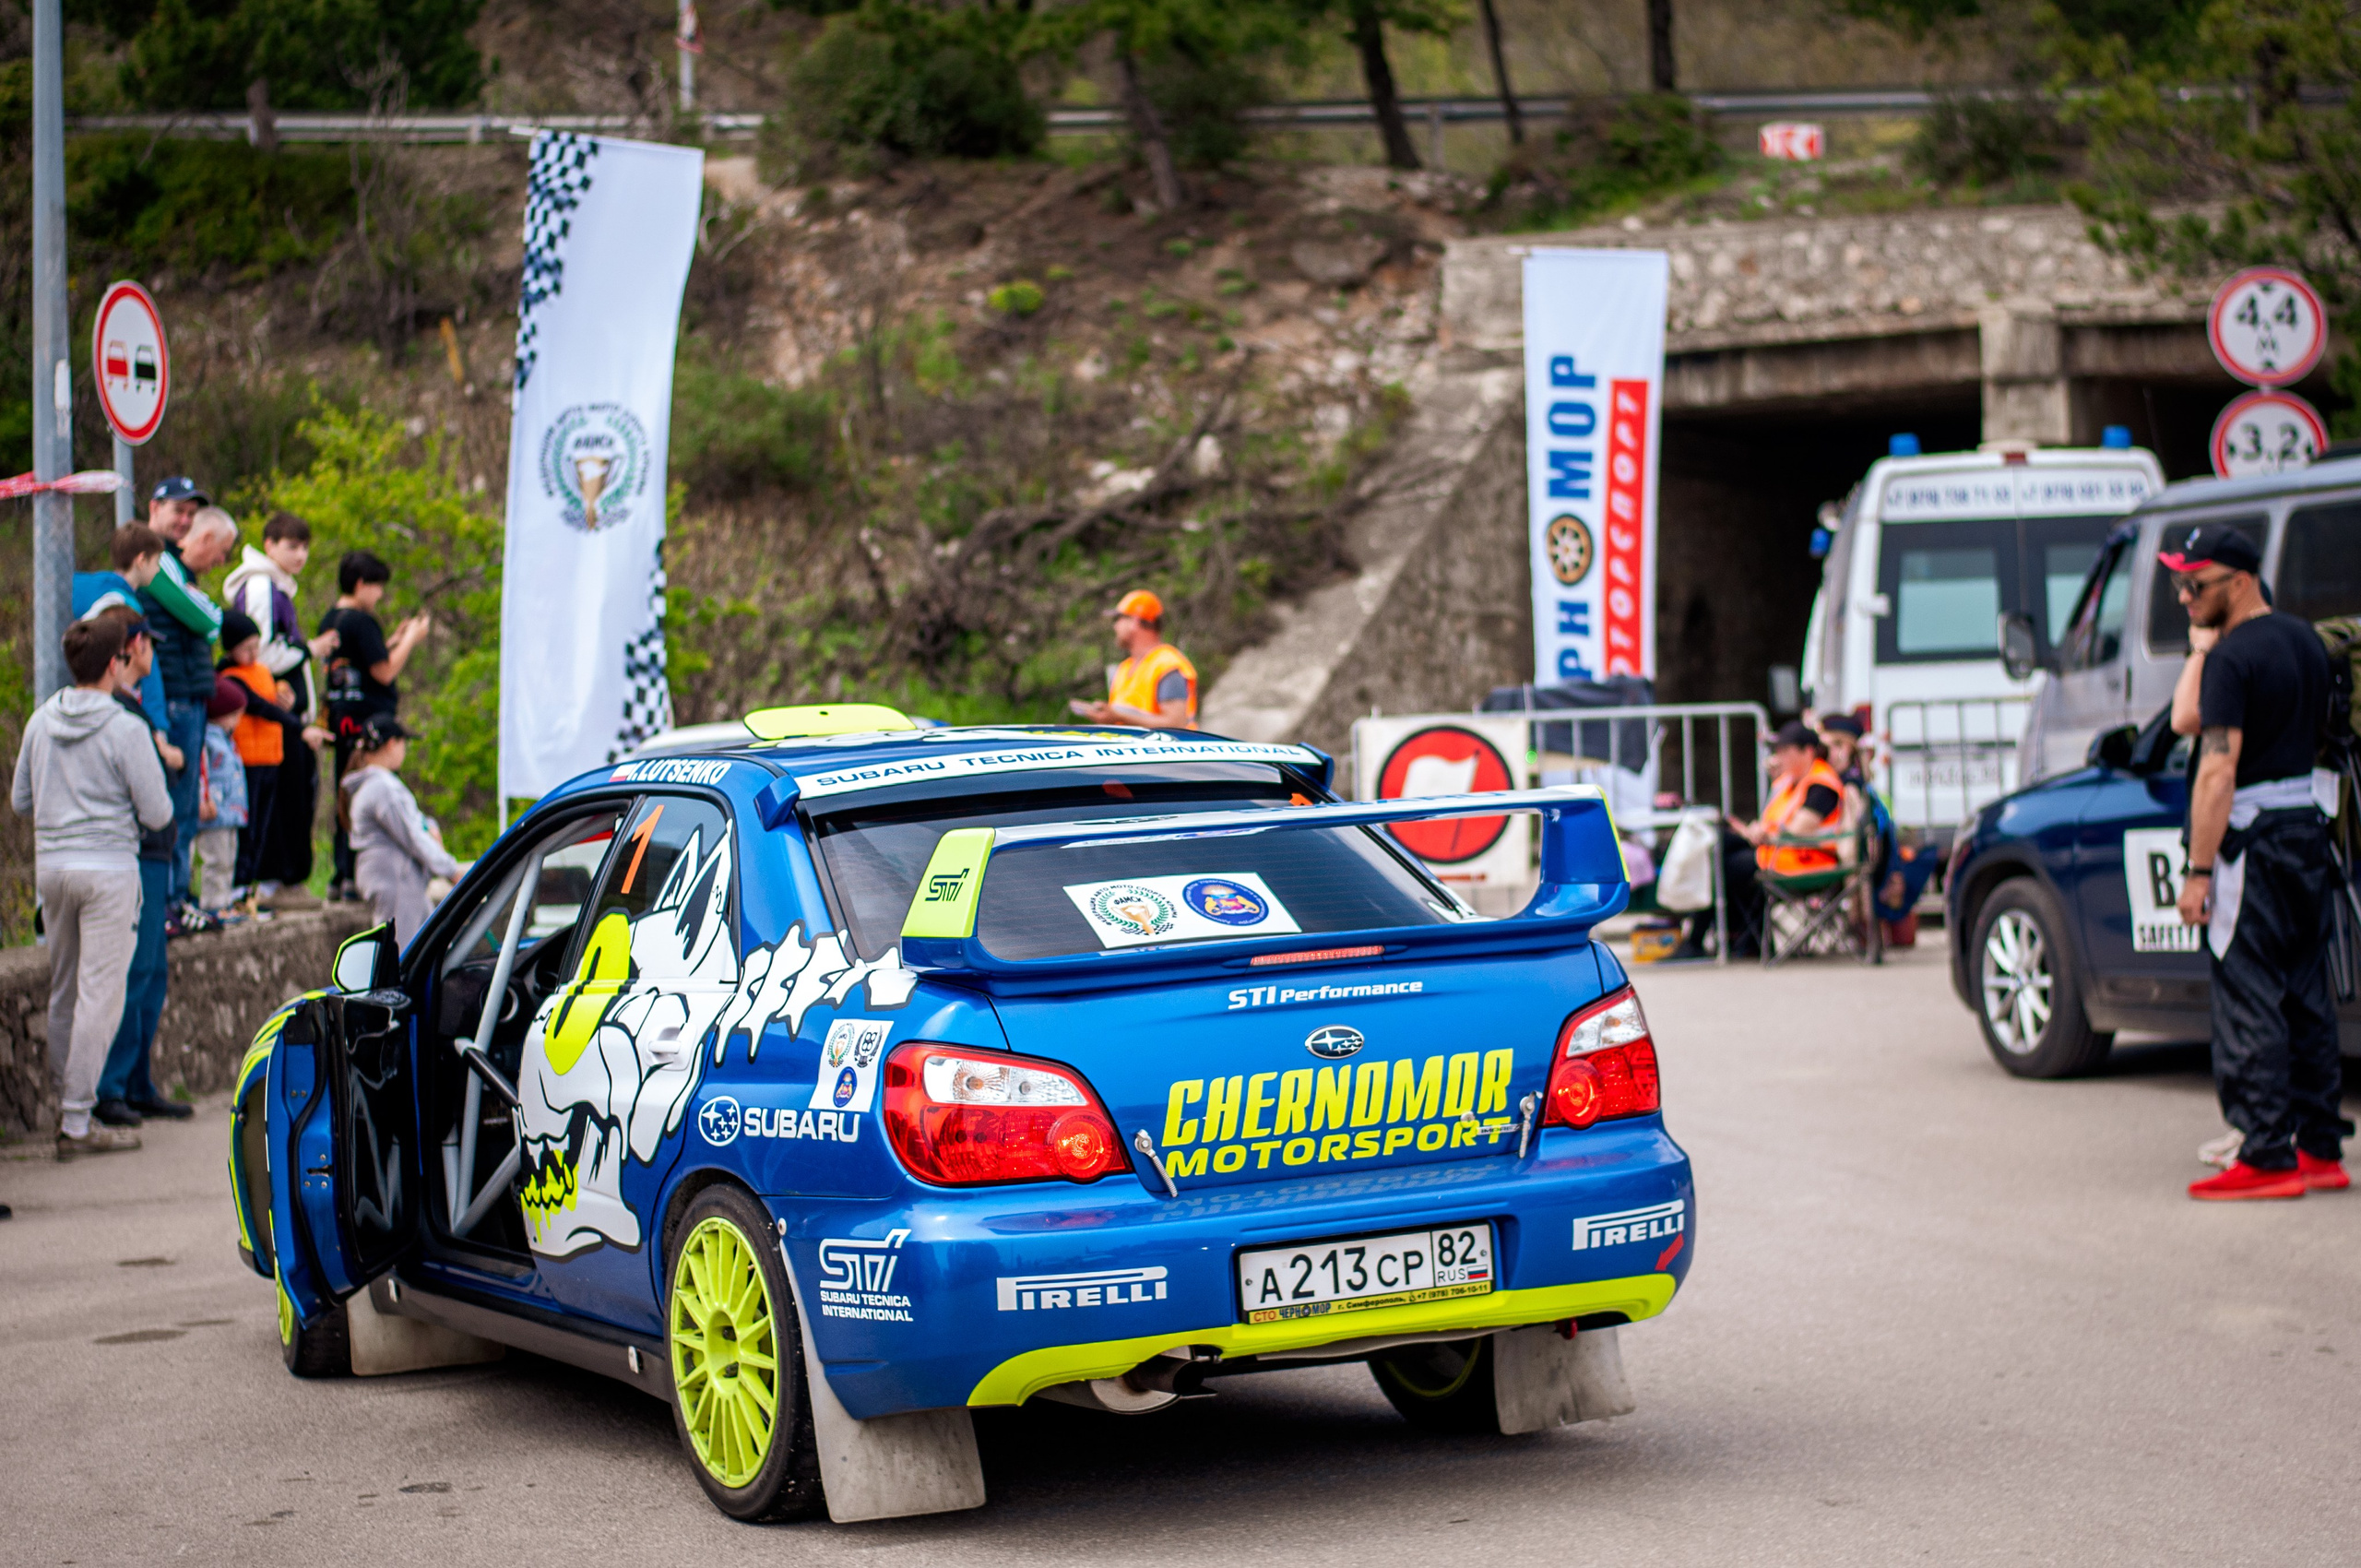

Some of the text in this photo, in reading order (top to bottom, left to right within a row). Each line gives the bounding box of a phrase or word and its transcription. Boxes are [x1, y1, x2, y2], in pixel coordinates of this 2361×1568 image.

[1608, 388, 1641, 675] ОТОРСПОРТ
[626, 759, 732, 785] I.LUTSENKO
[816, 743, 1300, 787] SUBARU TECNICA INTERNATIONAL
[621, 804, 665, 895] 1
[1228, 980, 1423, 1010] STI Performance
[1161, 1047, 1514, 1147] CHERNOMOR
[743, 1107, 860, 1143] SUBARU
[1164, 1116, 1512, 1179] MOTORSPORT
[1572, 1199, 1685, 1251] PIRELLI
[819, 1228, 912, 1292] STI
[1438, 1230, 1477, 1266] 82
[996, 1266, 1169, 1311] PIRELLI
[1437, 1267, 1467, 1283] RUS
[820, 1290, 912, 1307] SUBARU TECNICA
[822, 1304, 914, 1322] INTERNATIONAL
[1253, 1310, 1277, 1323] СТО
[1417, 1291, 1427, 1301] +7
